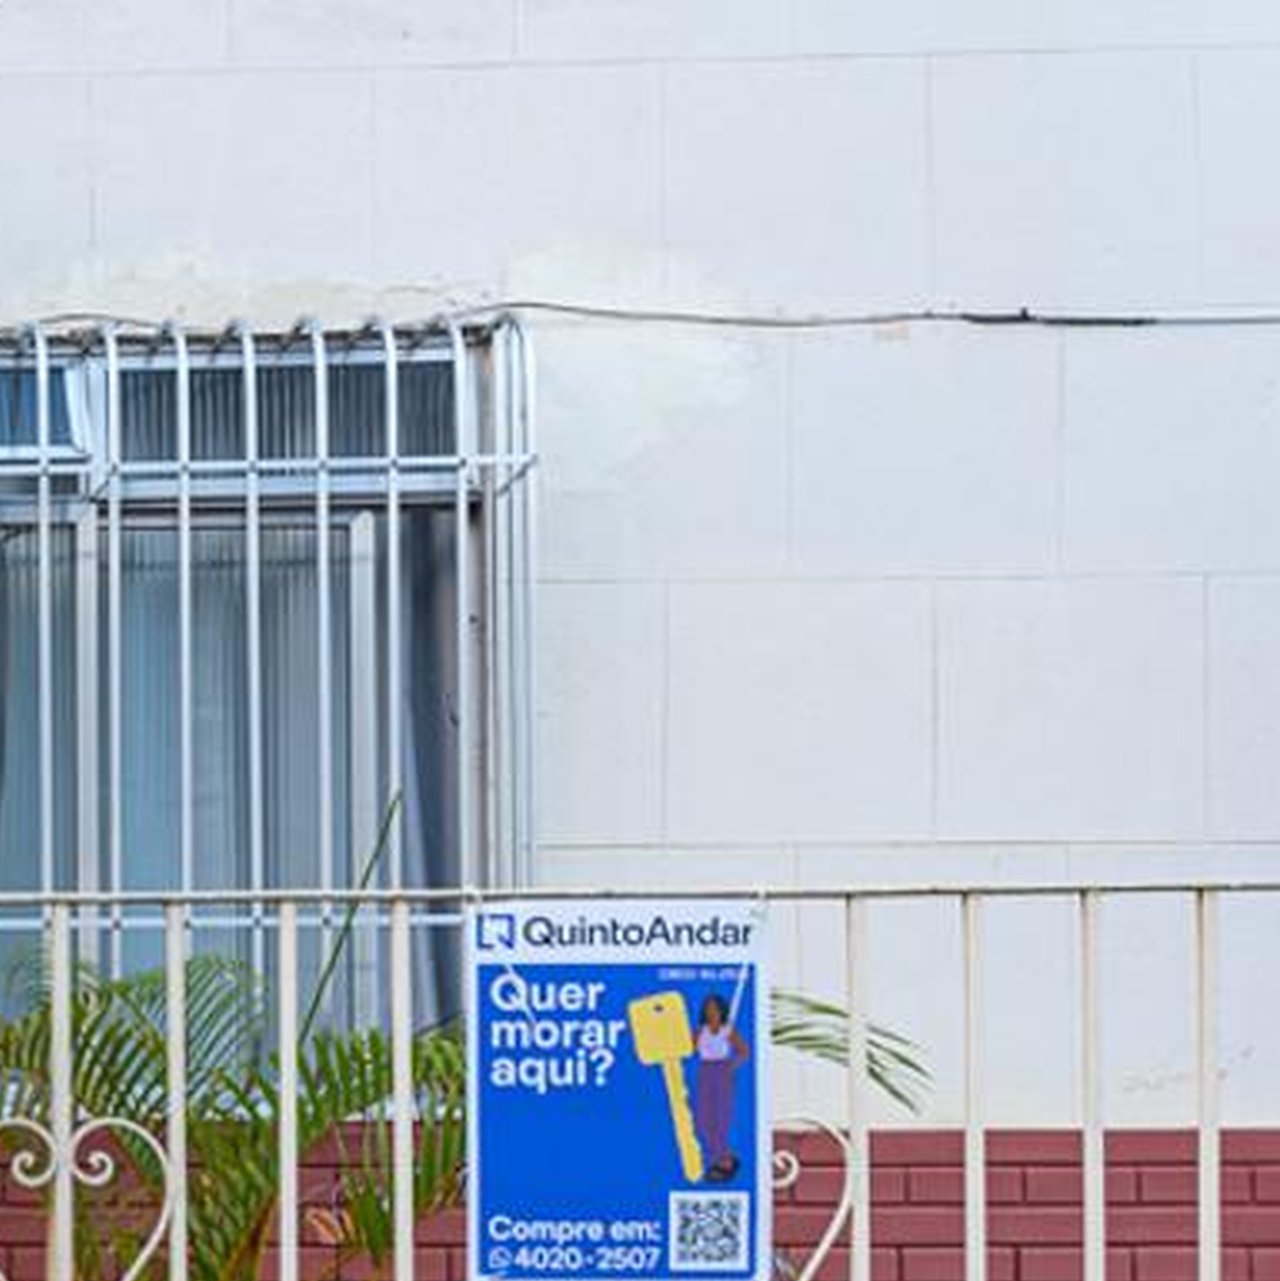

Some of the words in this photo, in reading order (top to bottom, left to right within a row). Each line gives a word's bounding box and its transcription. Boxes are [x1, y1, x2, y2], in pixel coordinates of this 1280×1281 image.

[523, 915, 752, 947] QuintoAndar
[490, 972, 606, 1012] Quer
[491, 1017, 626, 1049] morar
[491, 1049, 615, 1095] aqui?
[489, 1215, 604, 1245] Compre
[610, 1219, 662, 1242] em:
